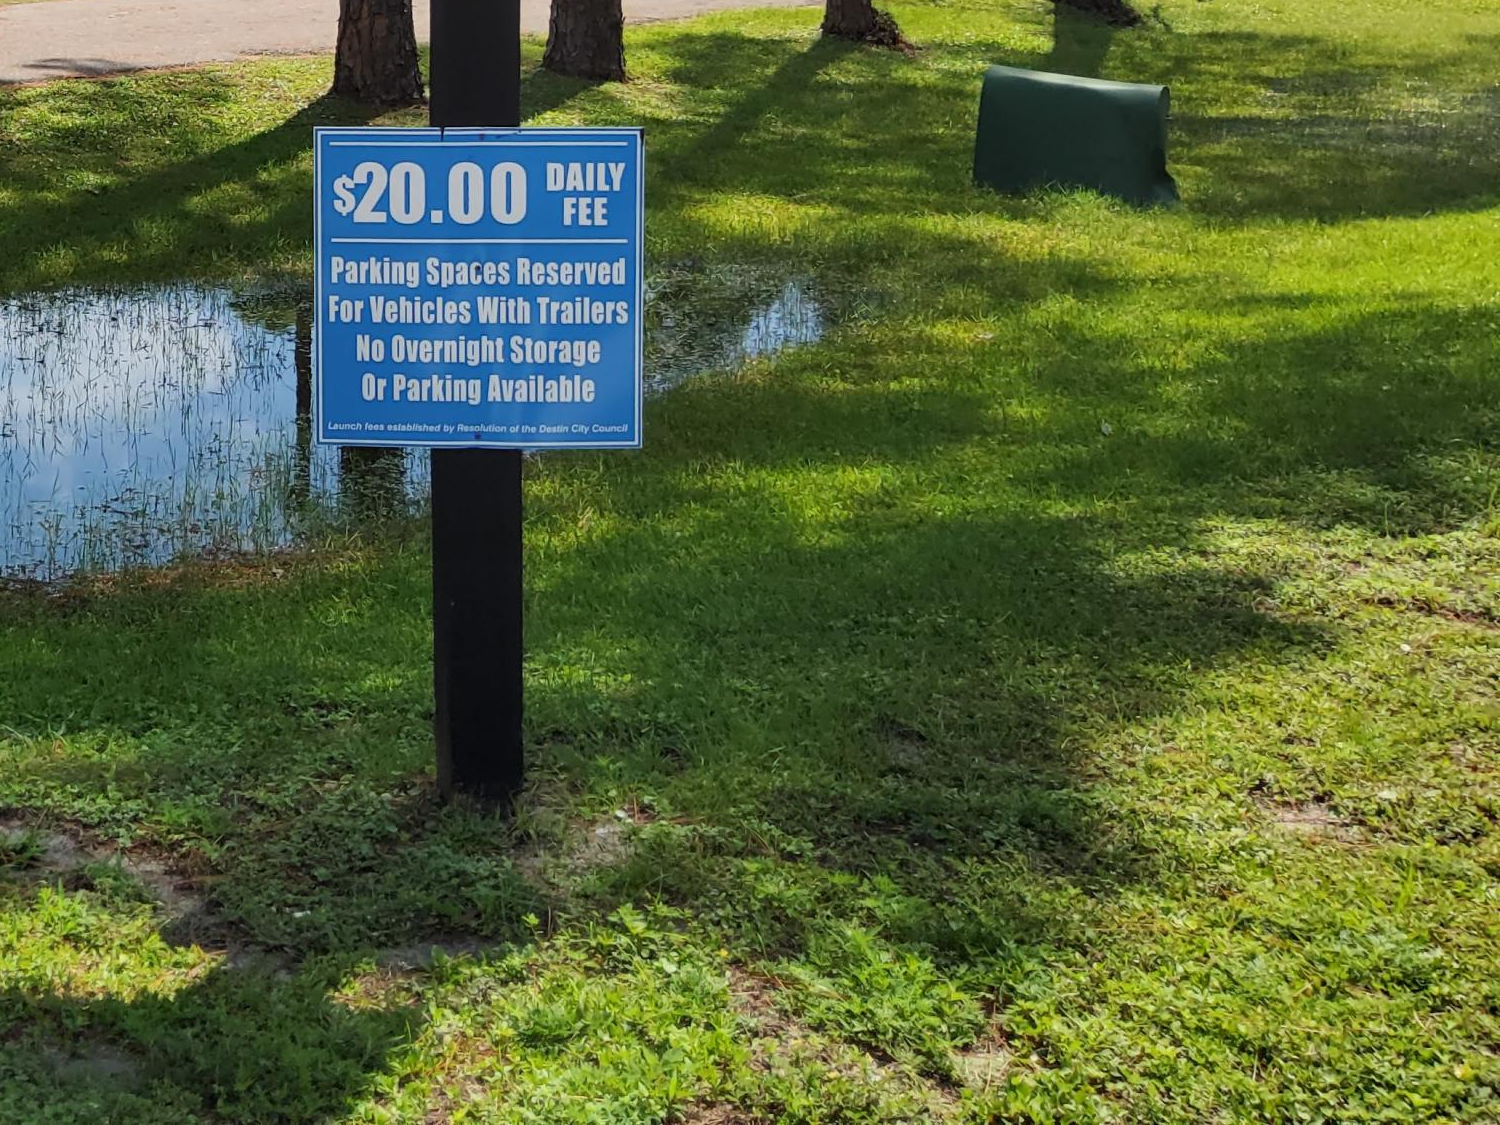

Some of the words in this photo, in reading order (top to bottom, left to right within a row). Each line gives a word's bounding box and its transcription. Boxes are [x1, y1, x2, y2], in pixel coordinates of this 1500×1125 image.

[547, 162, 625, 191] DAILY
[333, 162, 527, 224] $20.00
[563, 197, 608, 226] FEE
[331, 256, 420, 288] Parking
[426, 257, 510, 288] Spaces
[517, 258, 625, 285] Reserved
[329, 295, 364, 322] For
[370, 296, 471, 324] Vehicles
[477, 296, 530, 324] With
[537, 297, 628, 324] Trailers
[357, 334, 384, 362] No
[392, 335, 504, 366] Overnight
[510, 335, 601, 367] Storage
[362, 373, 387, 401] Or
[393, 374, 481, 405] Parking
[488, 374, 595, 403] Available
[328, 422, 362, 430] Launch
[365, 422, 385, 431] fees
[387, 423, 441, 432] established
[443, 424, 455, 434] by
[457, 424, 507, 432] Resolution
[509, 424, 520, 433] of
[521, 425, 537, 433] the
[538, 424, 569, 434] Destin
[571, 424, 590, 434] City
[592, 424, 628, 433] Council
